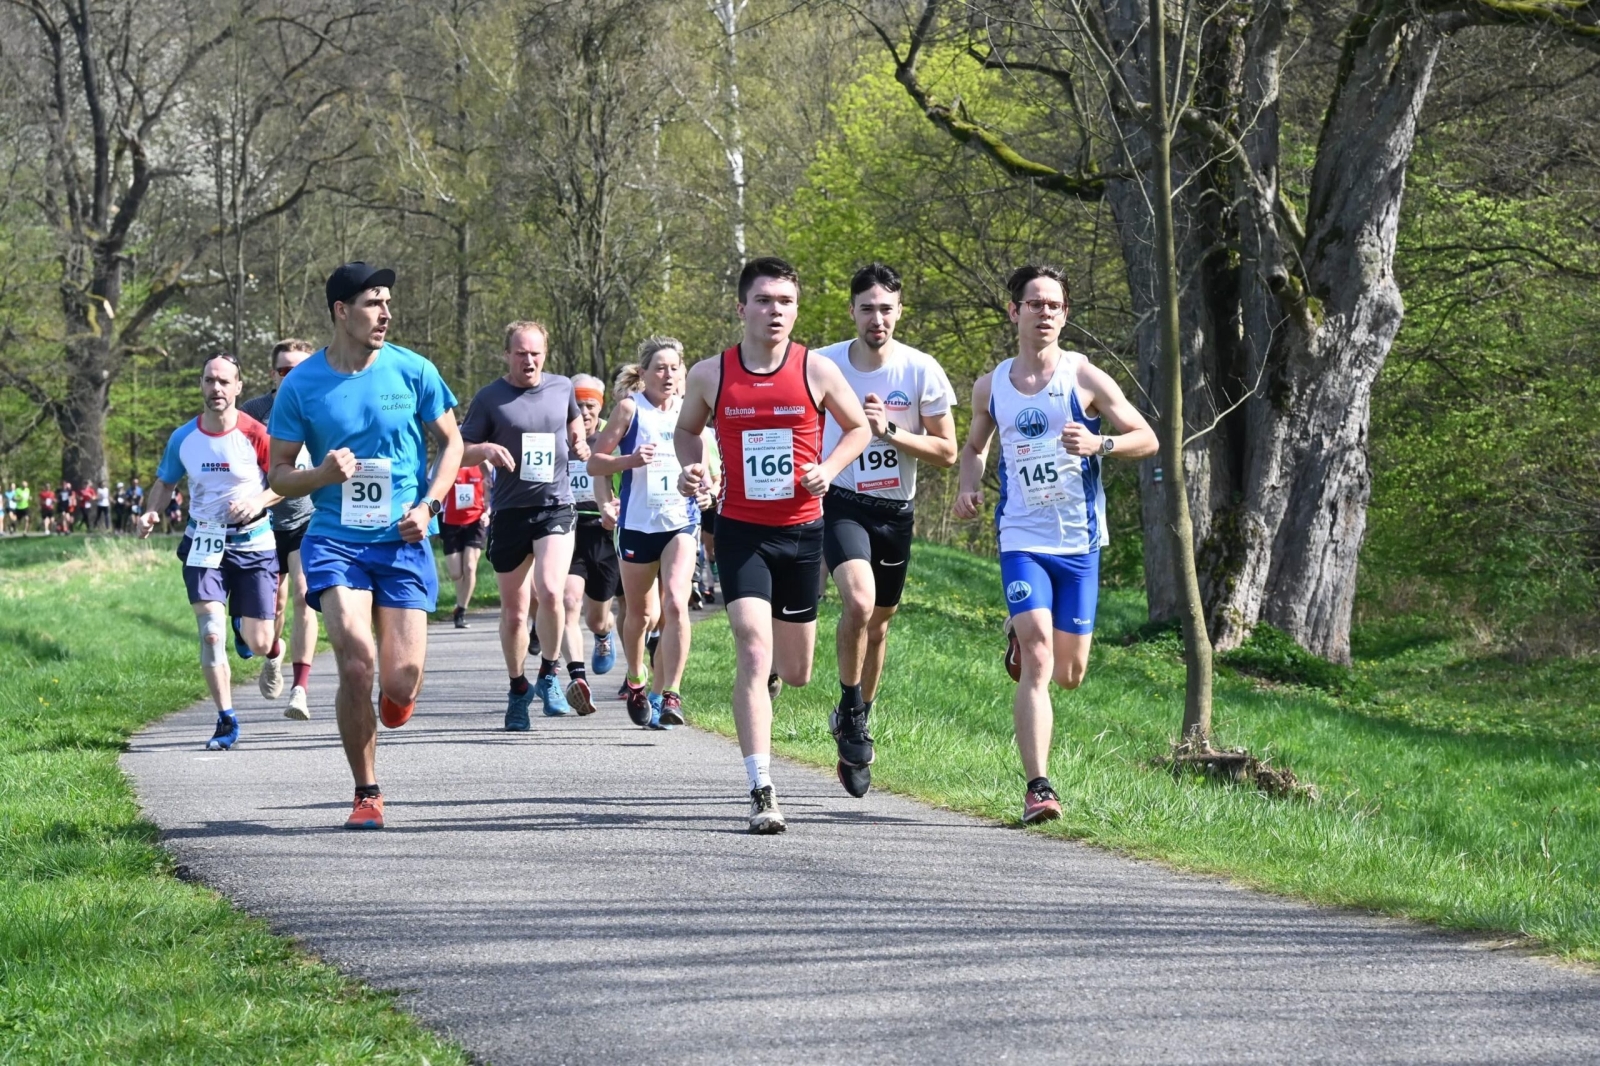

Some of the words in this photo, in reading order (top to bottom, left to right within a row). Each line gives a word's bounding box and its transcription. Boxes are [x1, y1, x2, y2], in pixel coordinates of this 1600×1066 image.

[524, 450, 552, 466] 131
[746, 454, 793, 476] 166
[854, 449, 898, 471] 198
[570, 475, 588, 489] 40
[660, 475, 668, 491] 1
[1018, 462, 1059, 486] 145
[351, 482, 382, 502] 30
[459, 493, 471, 502] 65
[833, 488, 875, 506] NIKE
[874, 500, 909, 510] PRO
[194, 536, 224, 554] 119
